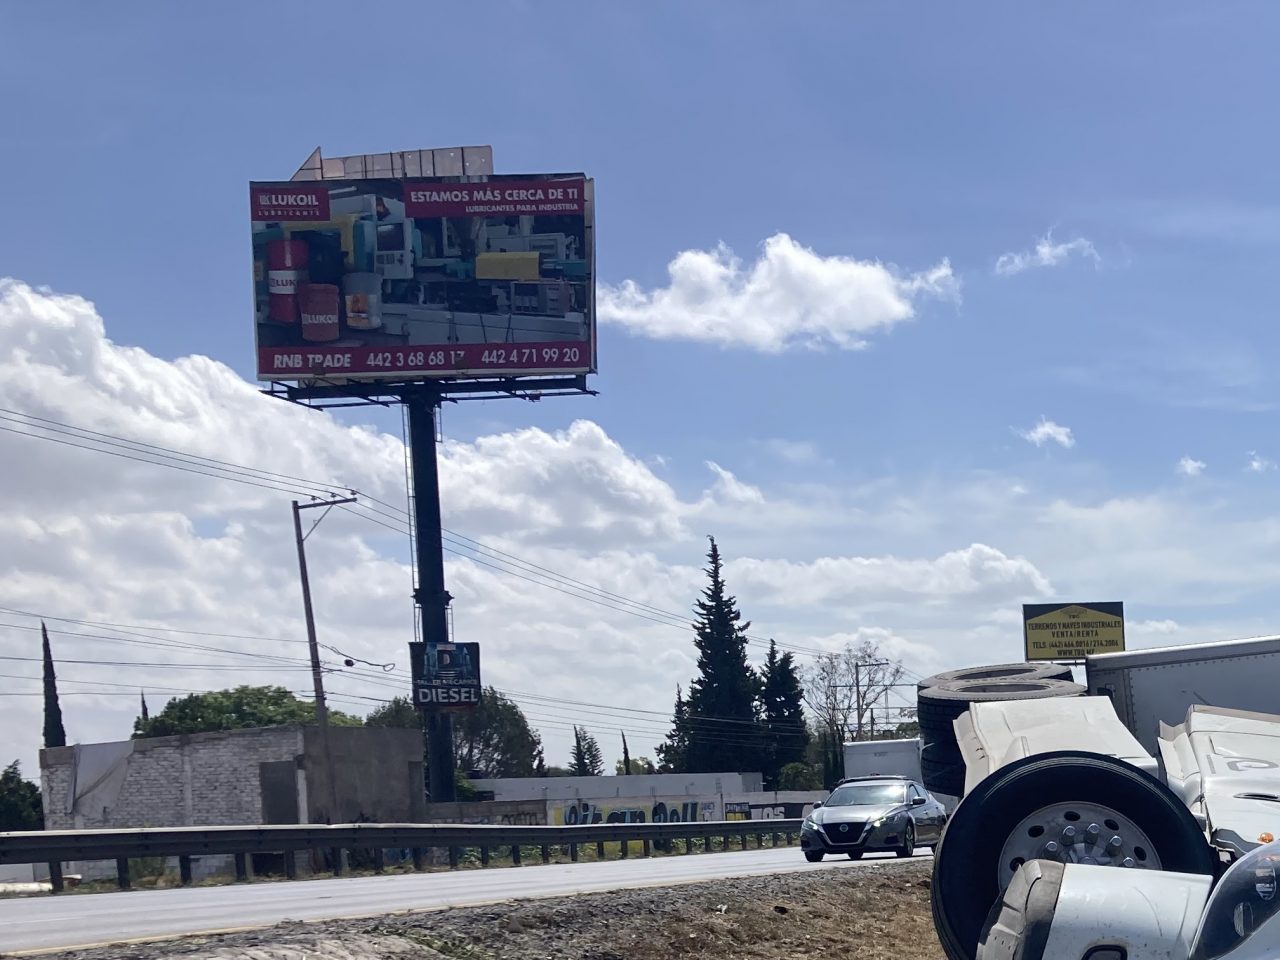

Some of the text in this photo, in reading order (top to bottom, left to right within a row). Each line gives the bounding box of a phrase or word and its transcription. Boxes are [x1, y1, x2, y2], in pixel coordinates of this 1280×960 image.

[271, 194, 319, 205] LUKOIL
[410, 188, 578, 202] ESTAMOS MÁS CERCA DE TI
[465, 203, 579, 213] LUBRICANTES PARA INDUSTRIA
[274, 354, 302, 369] RNB
[306, 354, 352, 368] TRADE
[366, 352, 392, 367] 442
[396, 352, 404, 366] 3
[407, 352, 425, 366] 68
[428, 351, 445, 365] 68
[481, 348, 579, 364] 442 4 71 99 20
[1028, 622, 1057, 630] TERRENOS
[1080, 621, 1121, 629] INDUSTRIALES
[418, 688, 479, 703] DIESEL
